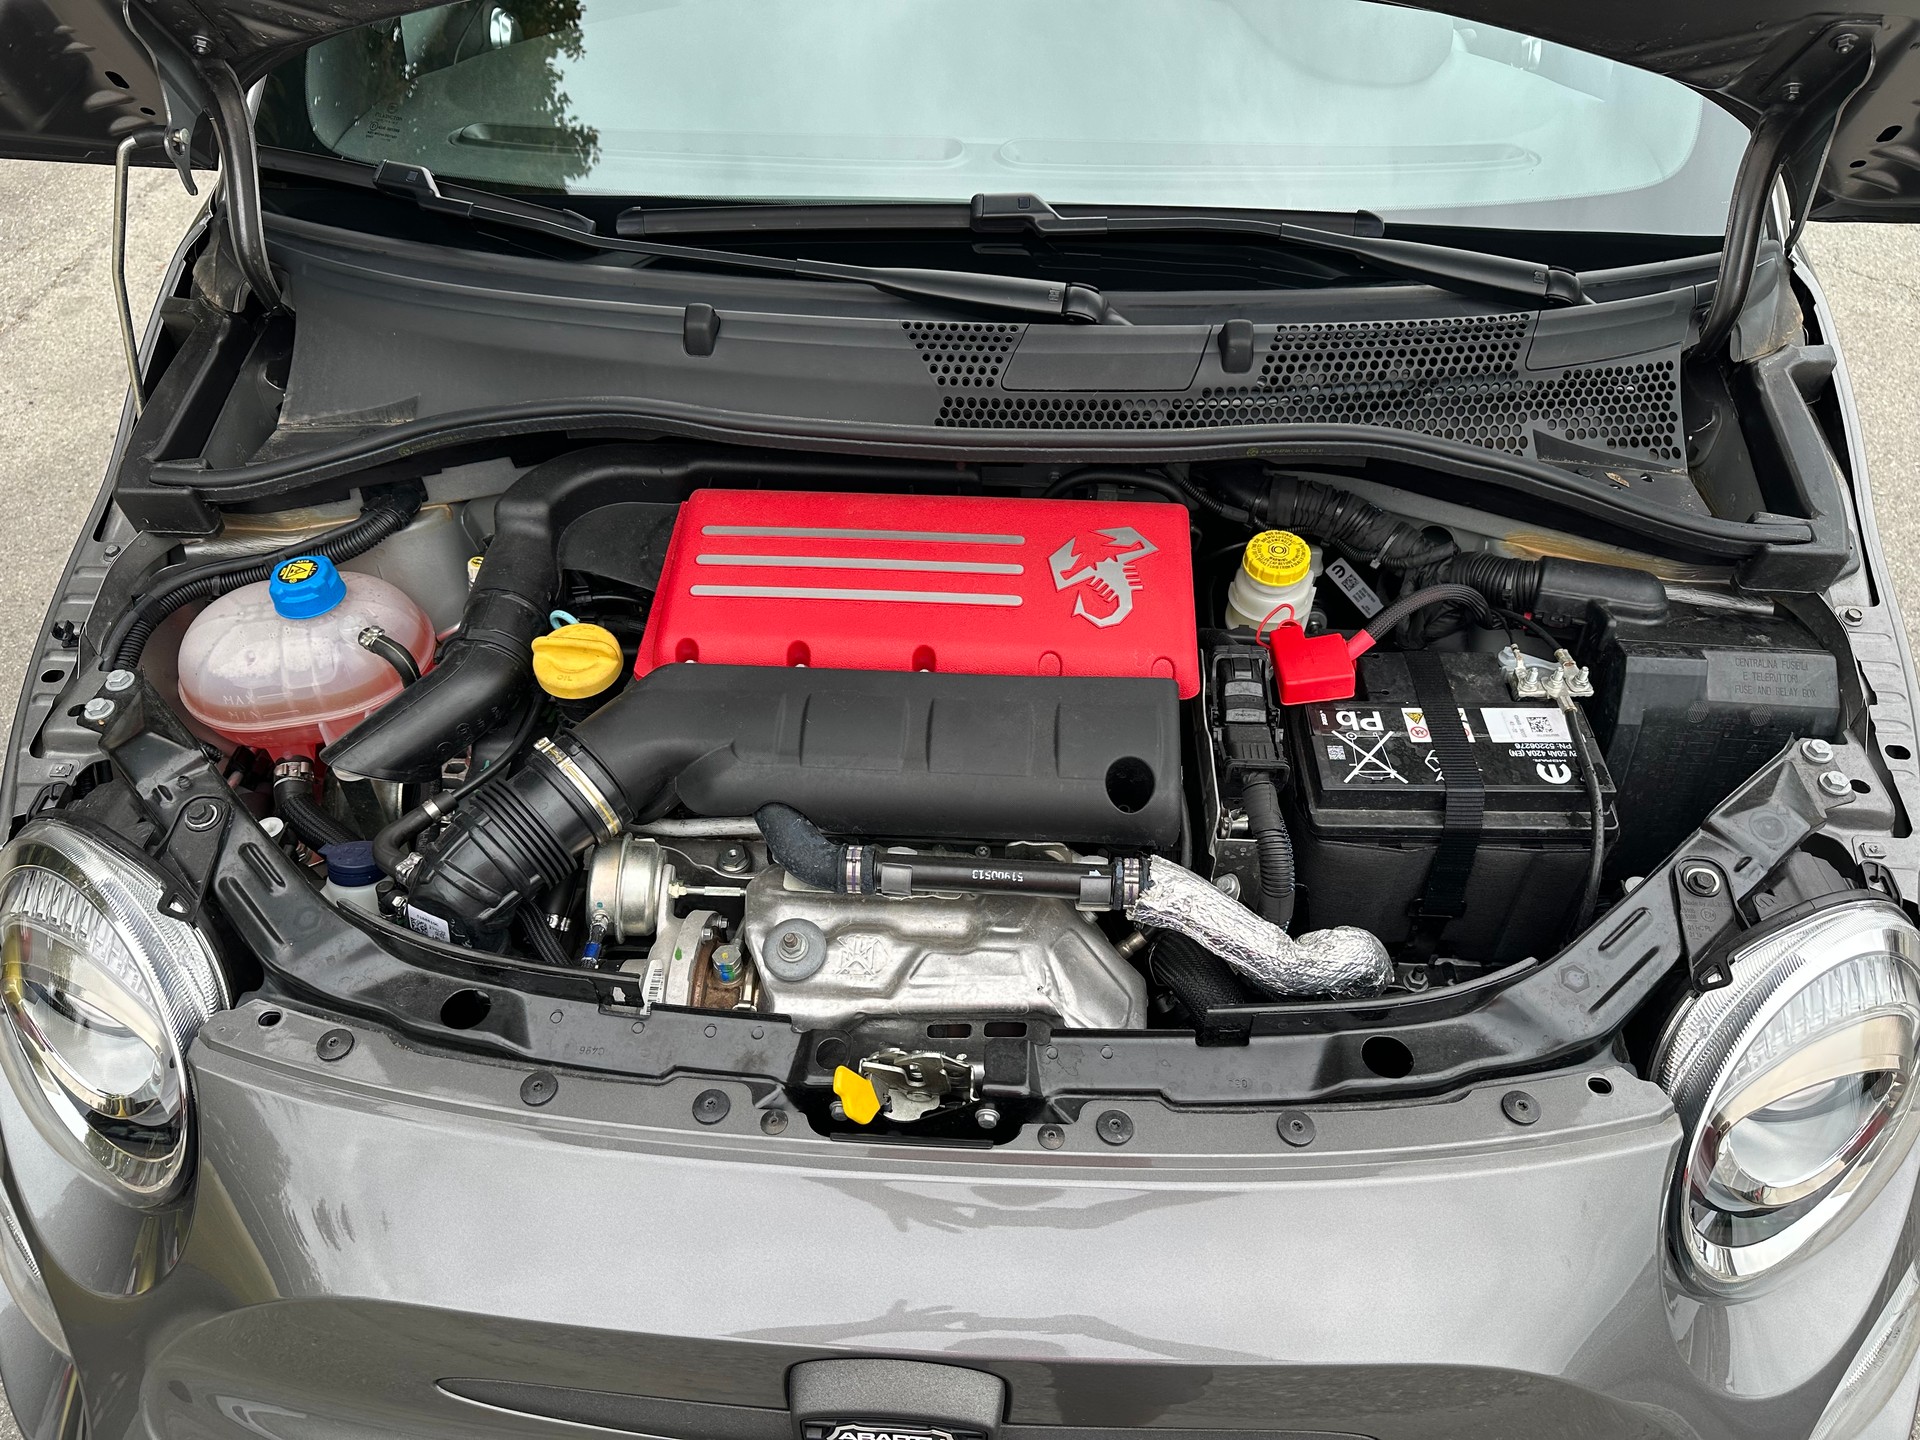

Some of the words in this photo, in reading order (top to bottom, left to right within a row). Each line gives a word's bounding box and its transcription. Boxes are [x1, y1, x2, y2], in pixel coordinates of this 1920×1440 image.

[1734, 657, 1778, 669] CENTRALINA
[556, 674, 573, 682] OIL
[1742, 671, 1748, 681] E
[1734, 684, 1753, 694] FUSE
[1757, 685, 1772, 696] AND
[1775, 686, 1798, 697] RELAY
[1802, 687, 1817, 698] BOX
[222, 692, 255, 707] MAX
[228, 711, 263, 720] MIN
[1336, 710, 1384, 731] Pb
